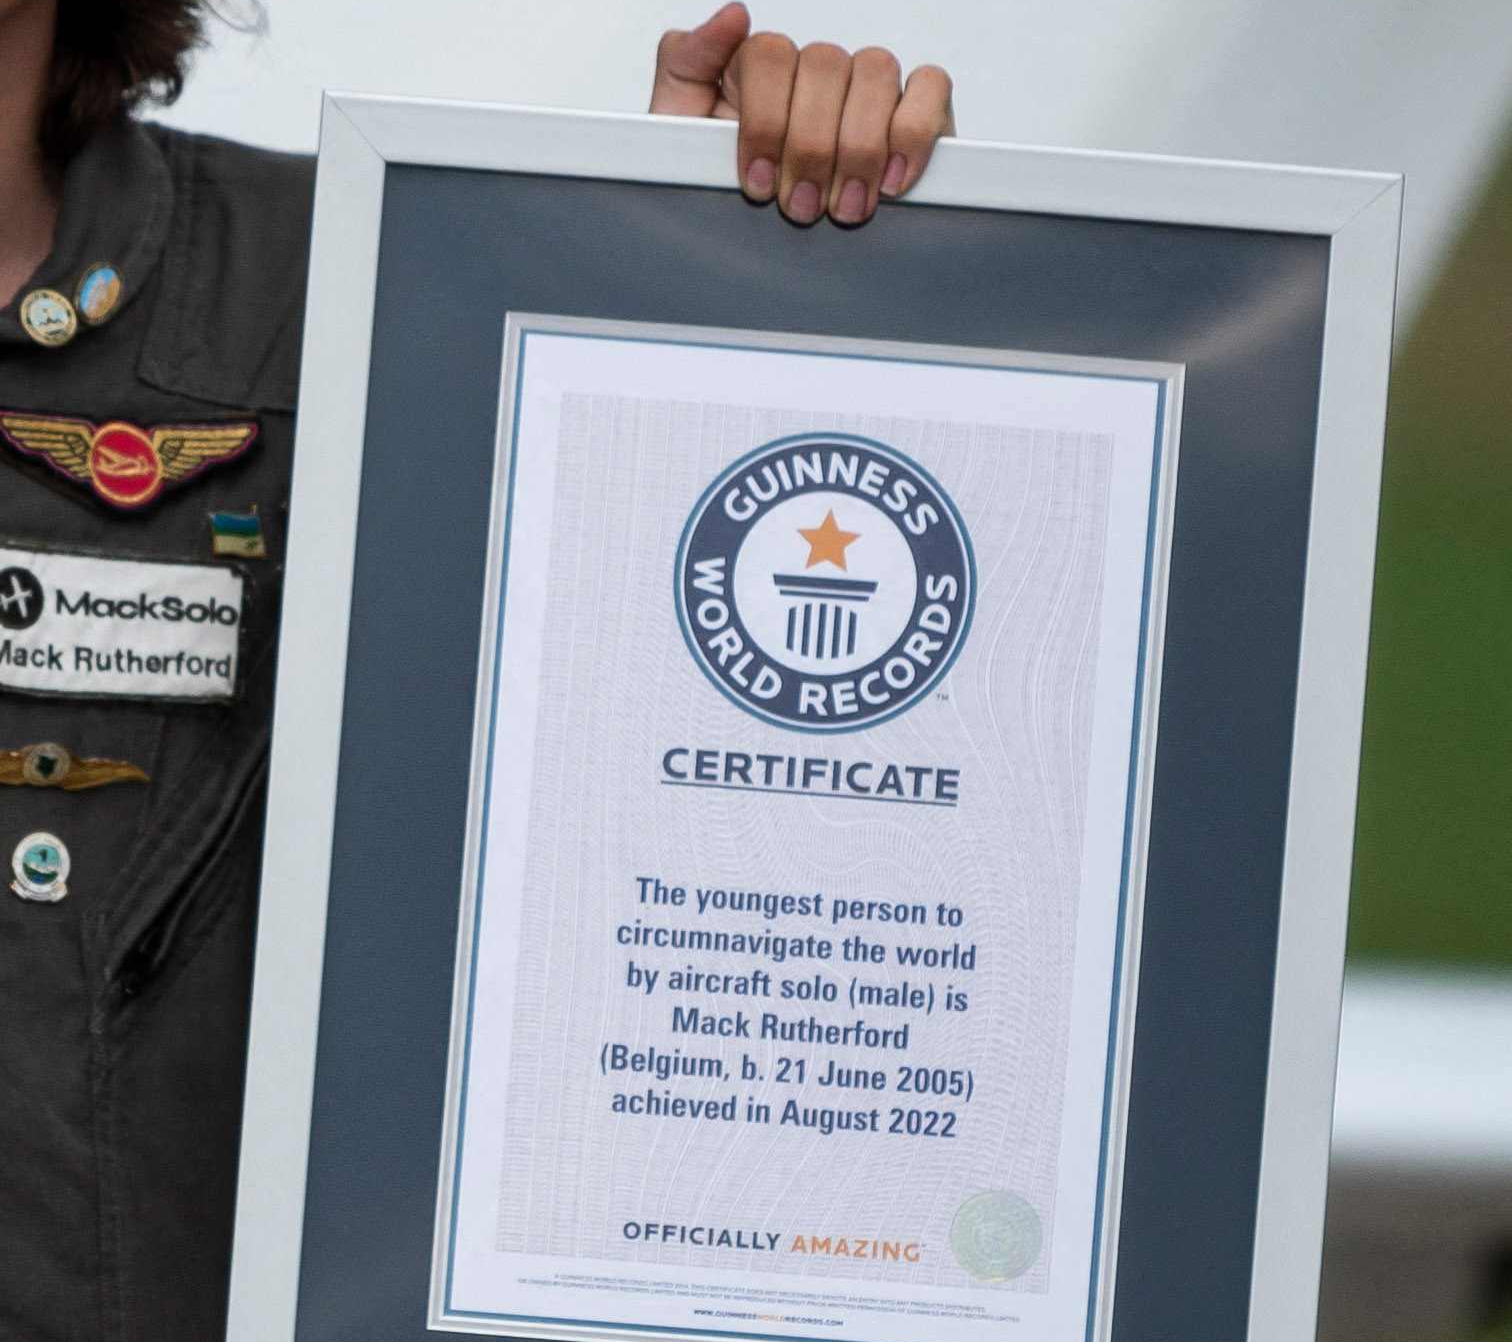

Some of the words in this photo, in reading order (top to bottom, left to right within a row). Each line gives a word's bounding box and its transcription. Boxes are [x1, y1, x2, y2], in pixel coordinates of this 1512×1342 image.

[724, 453, 939, 535] GUINNESS
[55, 588, 239, 626] MackSolo
[74, 646, 232, 677] Rutherford
[693, 557, 782, 699] WORLD
[799, 574, 957, 716] RECORDS
[662, 748, 960, 800] CERTIFICATE
[636, 877, 686, 905] The
[695, 884, 823, 919] youngest
[832, 896, 926, 925] person
[936, 902, 963, 927] to
[617, 921, 833, 962] circumnavigate
[842, 937, 885, 964] the
[896, 944, 977, 971] world
[627, 962, 659, 994] by
[668, 966, 771, 997] aircraft
[780, 976, 838, 1002] solo
[849, 980, 935, 1015] (male)
[945, 985, 968, 1012] is
[672, 1008, 749, 1038] Mack
[761, 1014, 909, 1050] Rutherford
[599, 1043, 730, 1082] (Belgium,
[741, 1054, 765, 1081] b.
[775, 1058, 806, 1084] 21
[818, 1062, 887, 1091] June
[897, 1067, 974, 1102] 2005)
[612, 1088, 736, 1122] achieved
[746, 1097, 771, 1124] in
[780, 1099, 879, 1136] August
[888, 1109, 957, 1138] 2022
[623, 1222, 780, 1251] OFFICIALLY
[791, 1234, 921, 1262] AMAZING
